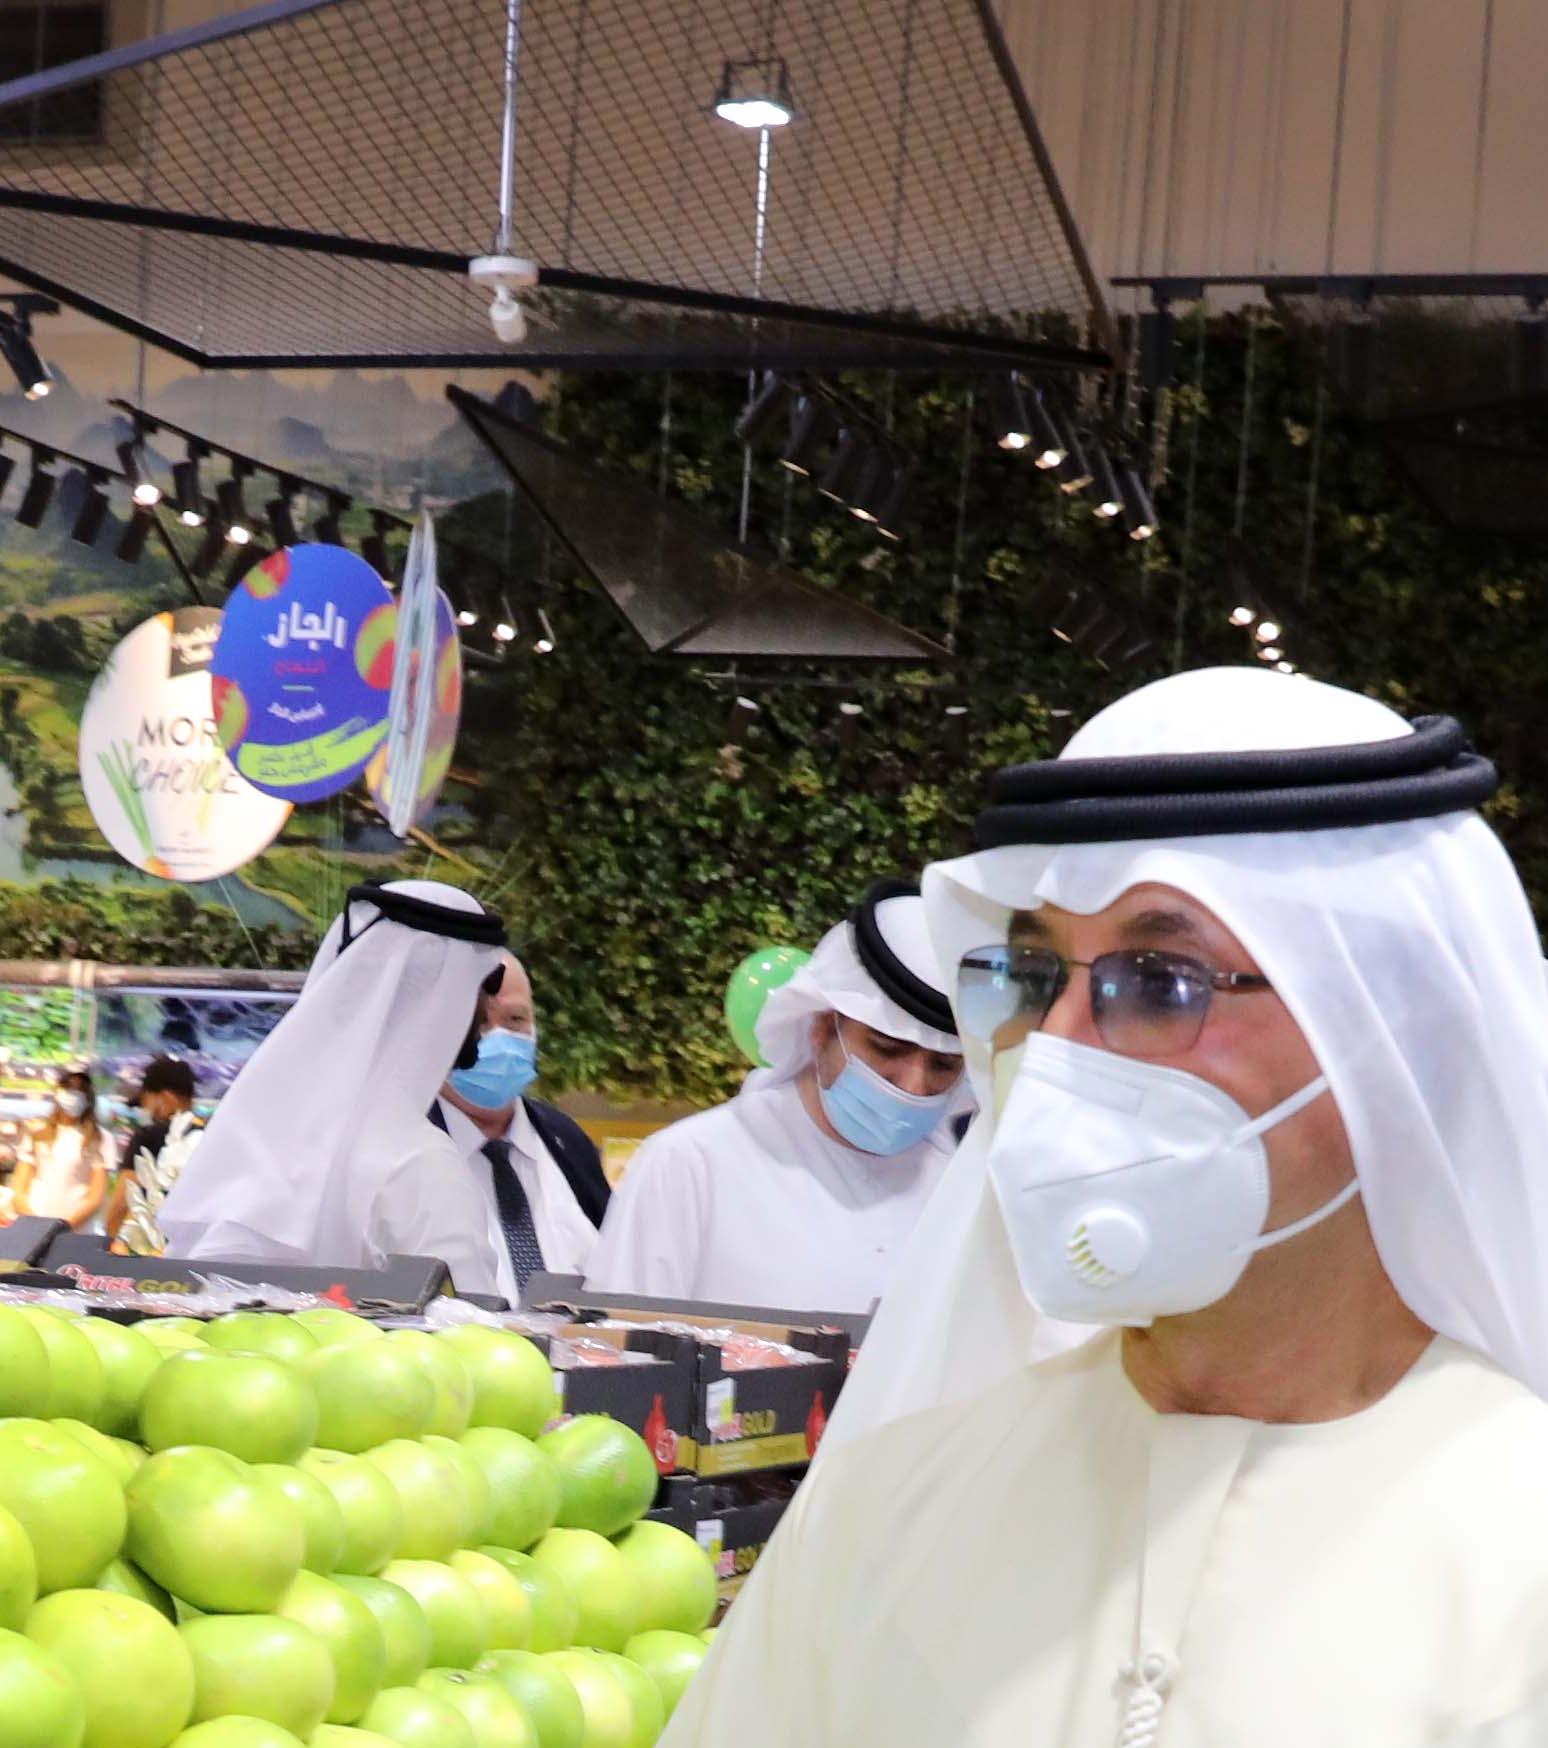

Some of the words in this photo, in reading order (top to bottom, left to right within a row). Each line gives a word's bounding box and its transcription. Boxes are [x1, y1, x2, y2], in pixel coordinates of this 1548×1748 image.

[137, 716, 222, 746] MOR
[130, 757, 240, 794] CHOICE
[136, 1279, 192, 1294] GO
[743, 1409, 776, 1435] GOLD
